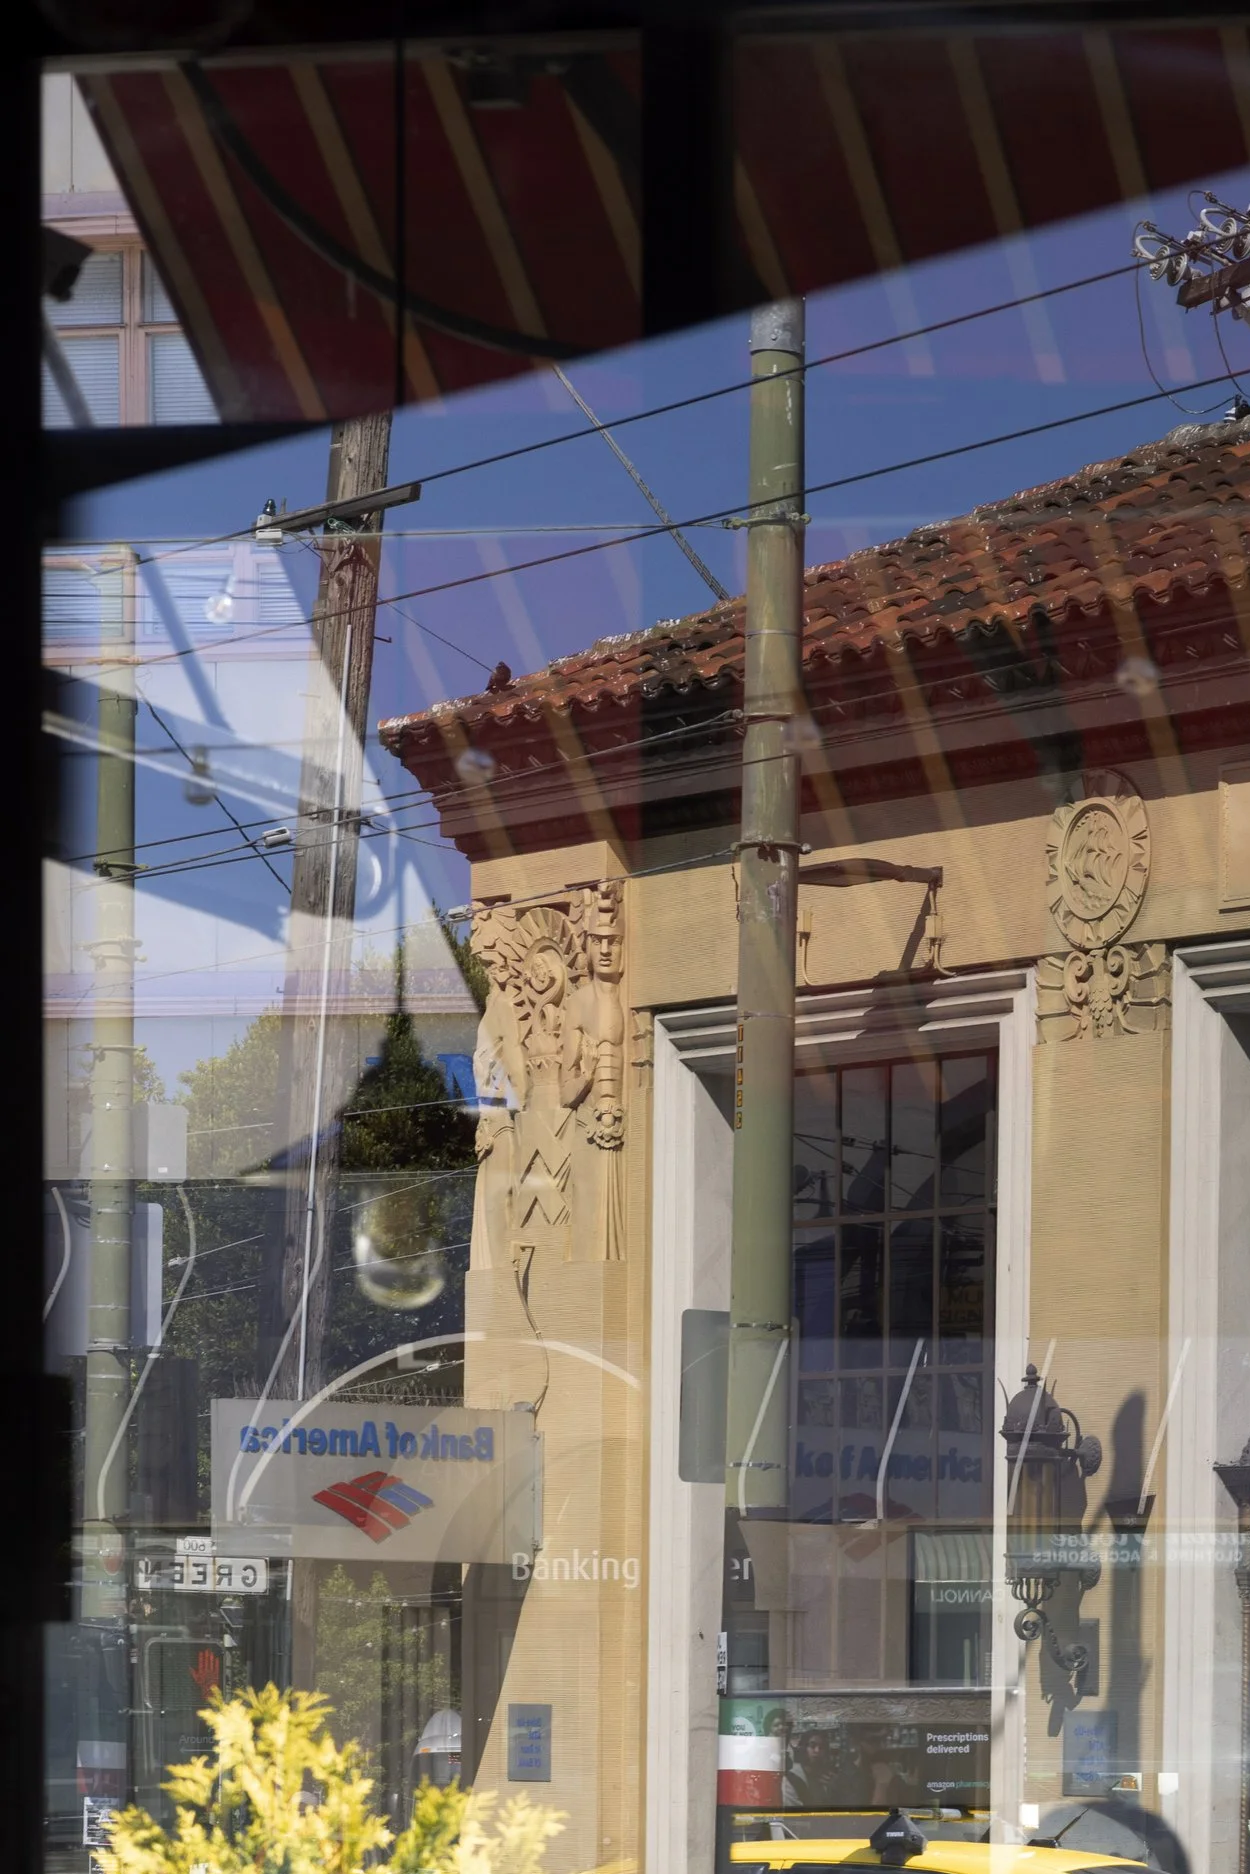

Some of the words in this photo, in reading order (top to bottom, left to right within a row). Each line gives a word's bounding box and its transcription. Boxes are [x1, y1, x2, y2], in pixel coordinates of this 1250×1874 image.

[511, 1548, 641, 1588] Banking
[926, 1732, 989, 1743] Prescriptions
[926, 1744, 970, 1754] delivered
